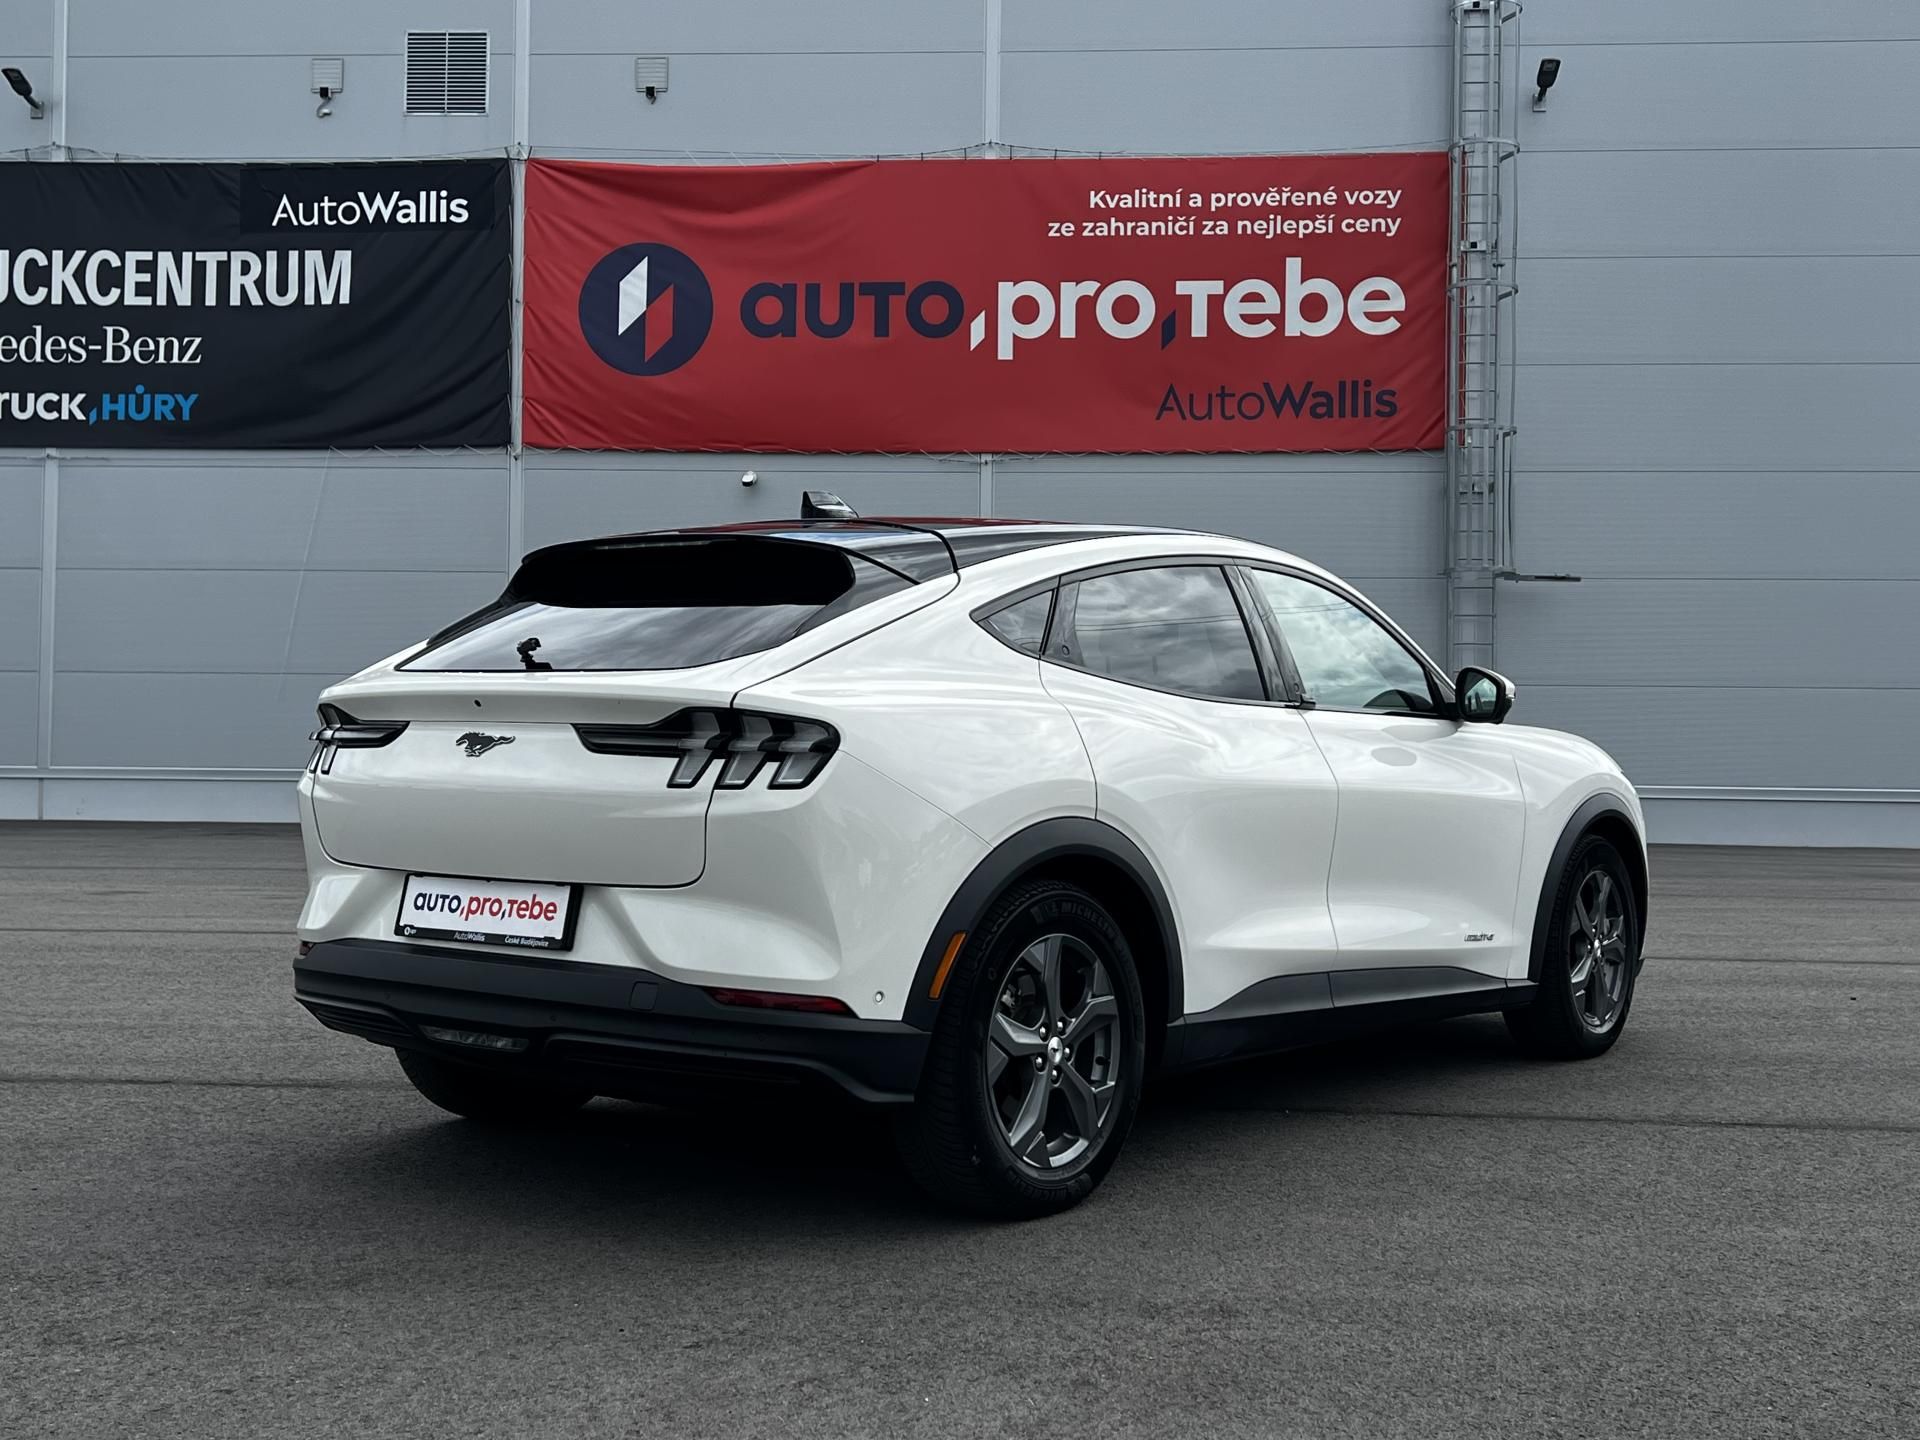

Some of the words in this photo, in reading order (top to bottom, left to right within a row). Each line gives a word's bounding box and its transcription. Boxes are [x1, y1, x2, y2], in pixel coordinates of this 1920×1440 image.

[271, 190, 470, 227] AutoWallis
[1088, 187, 1184, 210] Kvalitní
[1188, 193, 1203, 209] a
[1210, 186, 1338, 212] prověřené
[1344, 188, 1402, 210] vozy
[1047, 221, 1076, 238] ze
[1081, 214, 1197, 237] zahraničí
[1202, 220, 1229, 236] za
[1236, 213, 1335, 239] nejlepší
[1341, 215, 1402, 237] ceny
[0, 248, 353, 307] CKCENTRUM
[1154, 379, 1398, 422] AutoWallis
